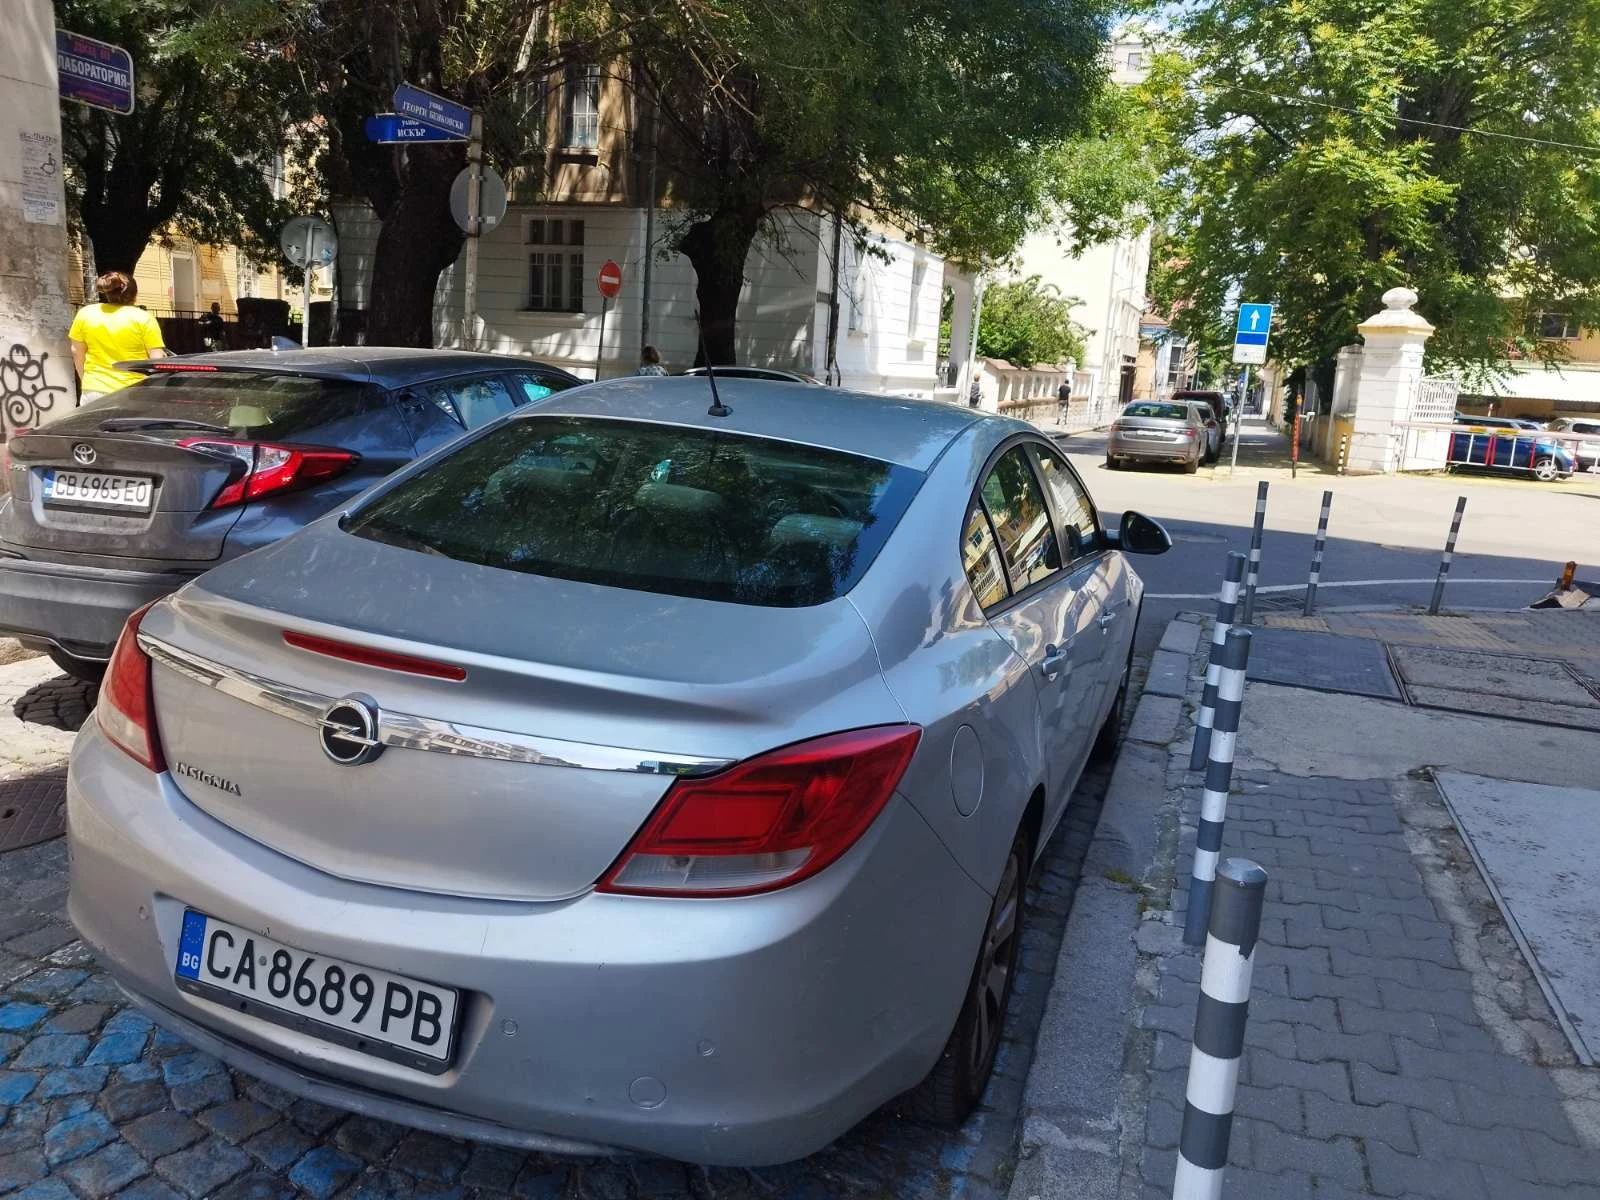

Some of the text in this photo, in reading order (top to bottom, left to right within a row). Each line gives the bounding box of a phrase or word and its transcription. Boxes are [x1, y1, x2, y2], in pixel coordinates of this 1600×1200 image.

[55, 474, 78, 496] CB
[81, 476, 120, 500] 6965
[176, 760, 242, 796] INSIGNIA
[181, 952, 199, 969] BG
[206, 929, 442, 1046] CA 8689 PB
